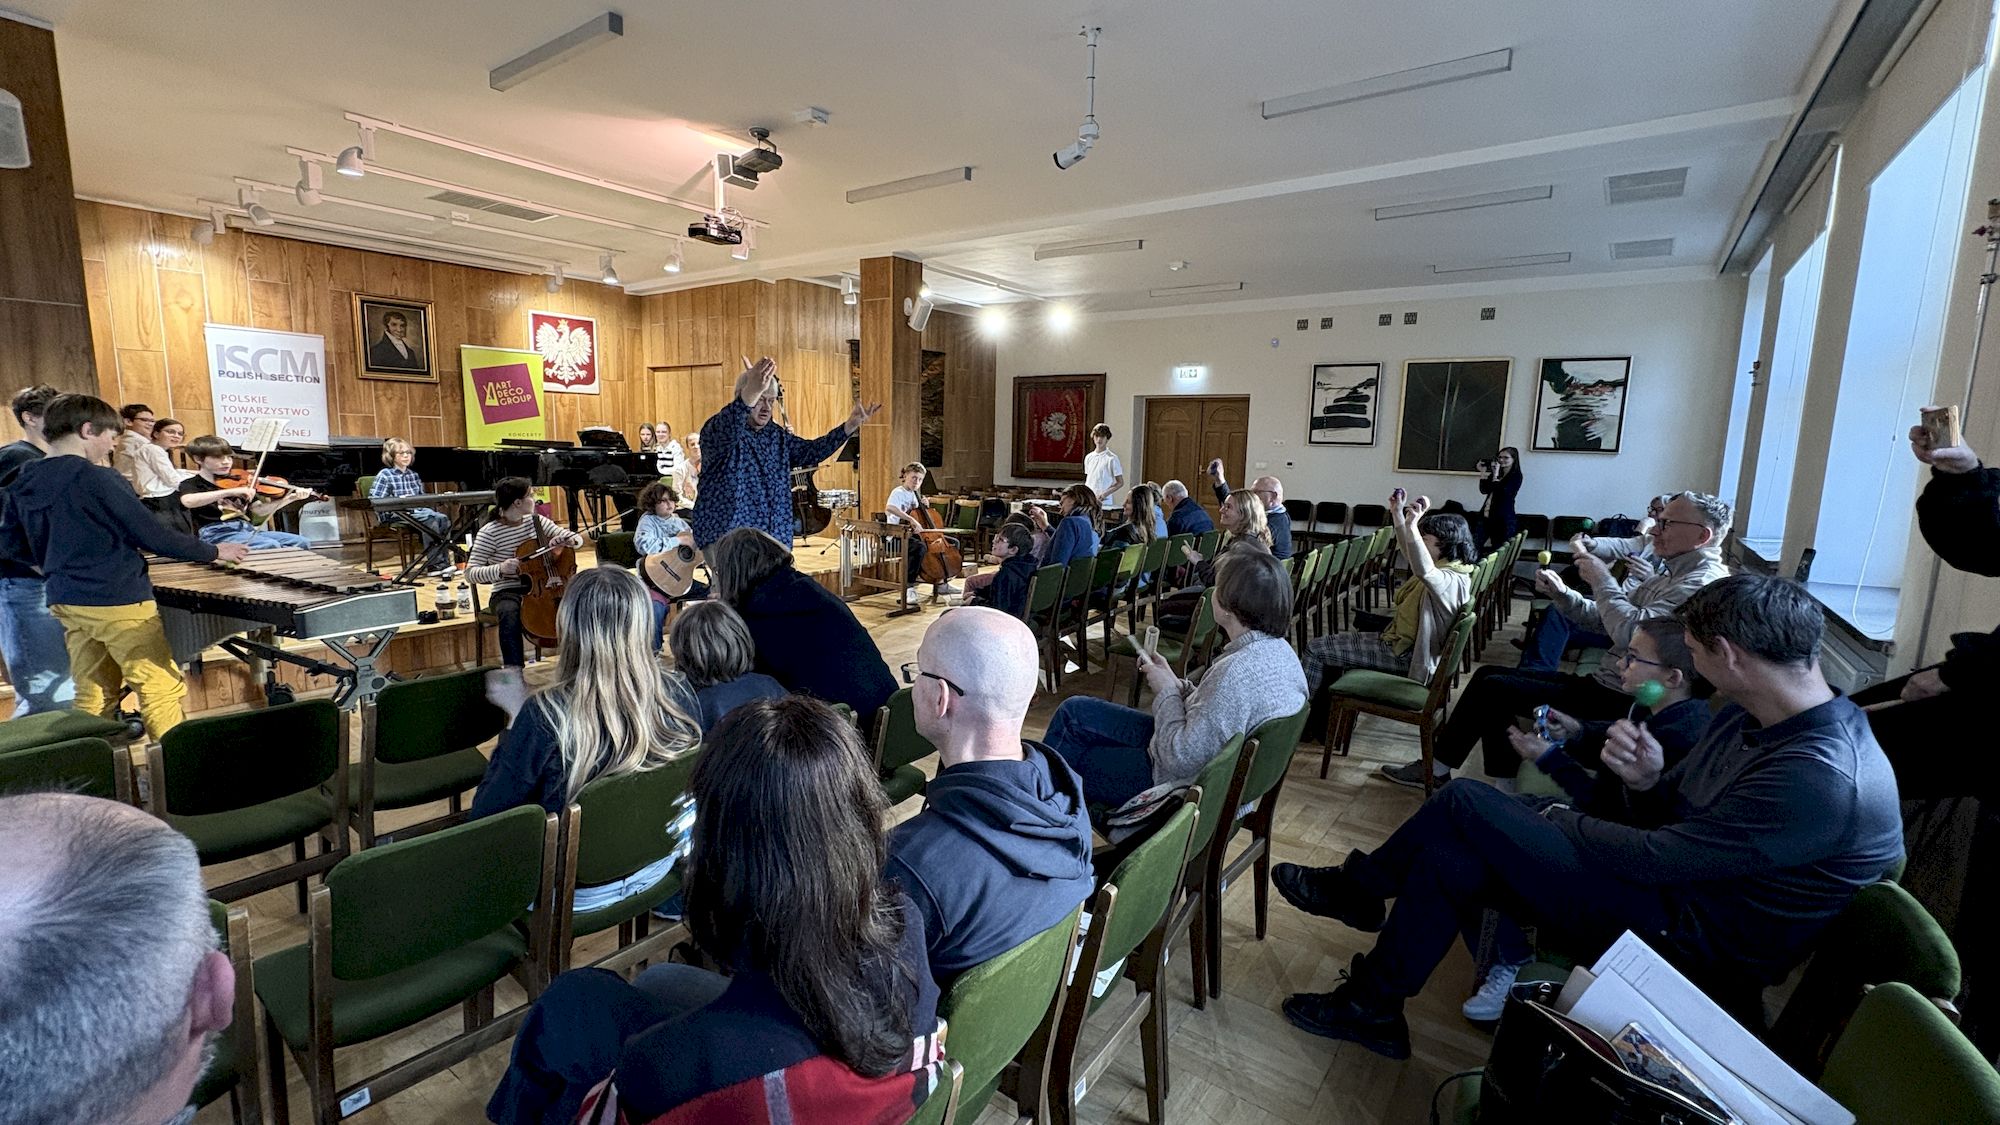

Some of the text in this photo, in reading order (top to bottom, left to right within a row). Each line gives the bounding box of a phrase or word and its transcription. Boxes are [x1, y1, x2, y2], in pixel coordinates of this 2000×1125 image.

[216, 344, 319, 379] ISCM
[218, 369, 321, 384] POLISH SECTION
[496, 380, 511, 390] ART
[497, 387, 524, 398] DECO
[221, 394, 268, 404] POLSKIE
[500, 394, 532, 406] GROUP
[221, 405, 310, 416] TOWARZYSTWO
[223, 416, 256, 425] MUZY
[224, 427, 311, 437] WSPSNEJ
